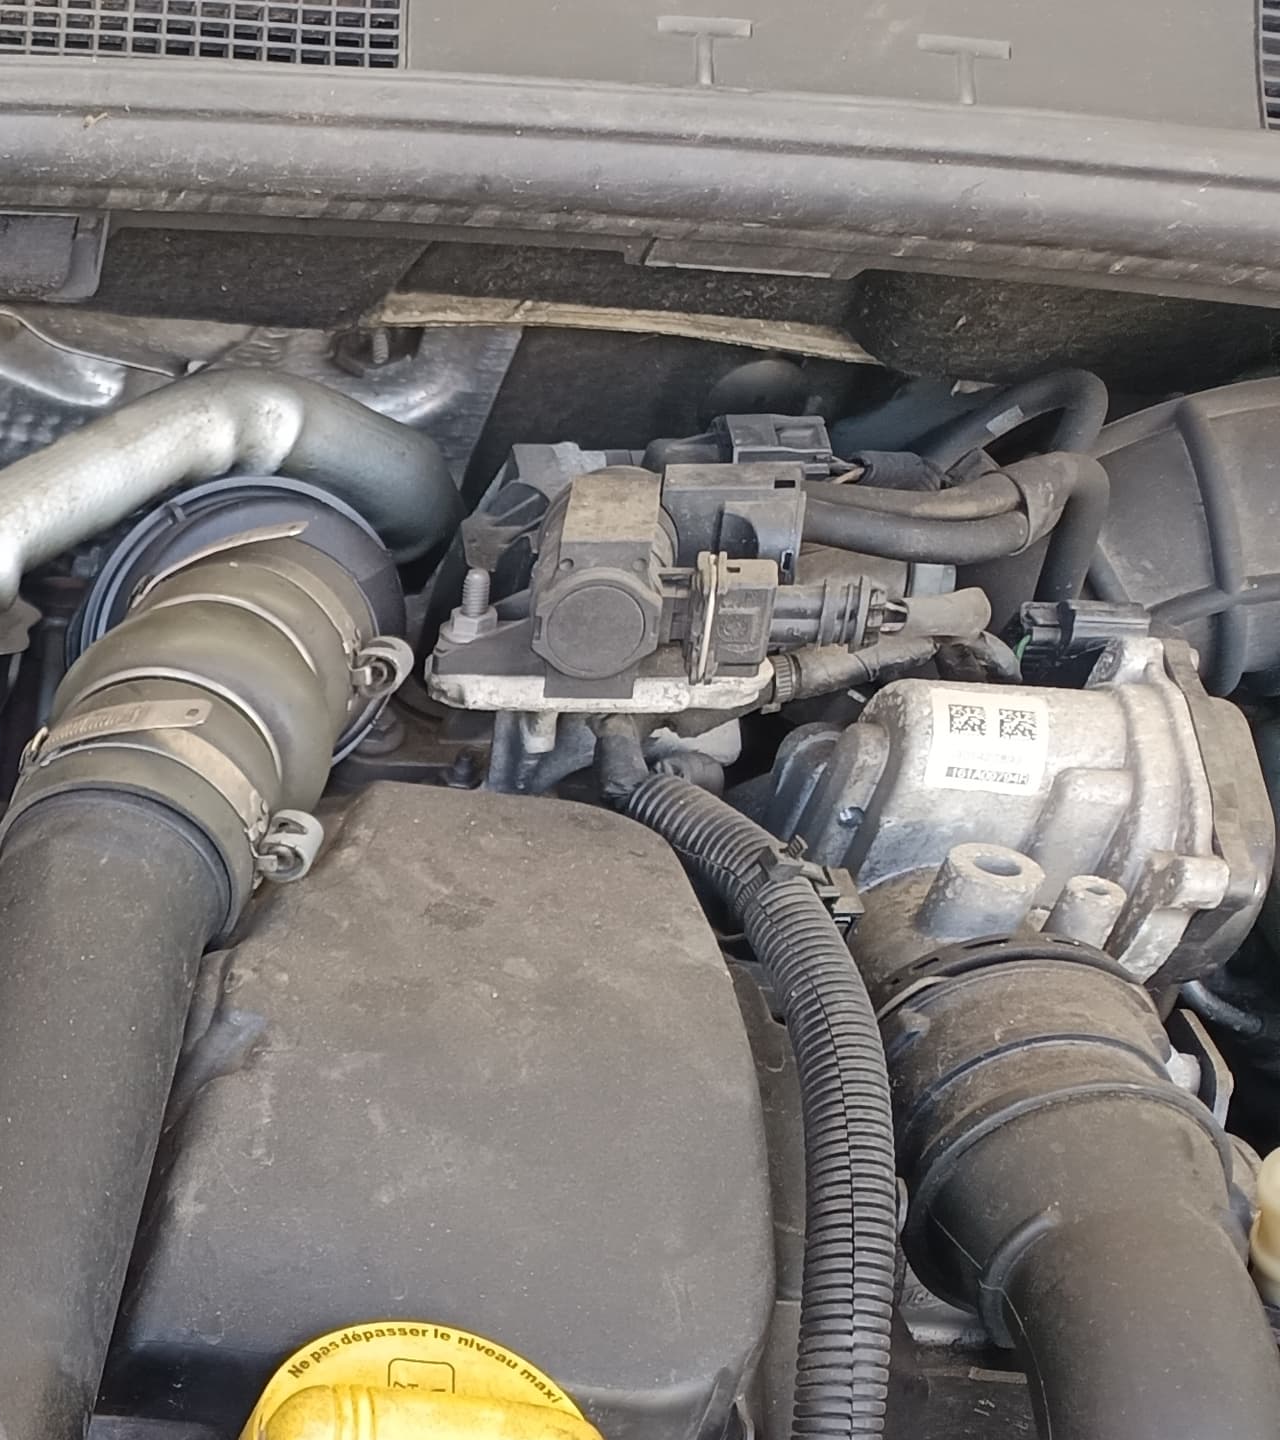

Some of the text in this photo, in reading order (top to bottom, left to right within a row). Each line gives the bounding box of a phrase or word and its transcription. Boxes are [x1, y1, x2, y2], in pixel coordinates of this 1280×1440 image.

[287, 1326, 564, 1405] Ne pas dépasser le niveau maxi
